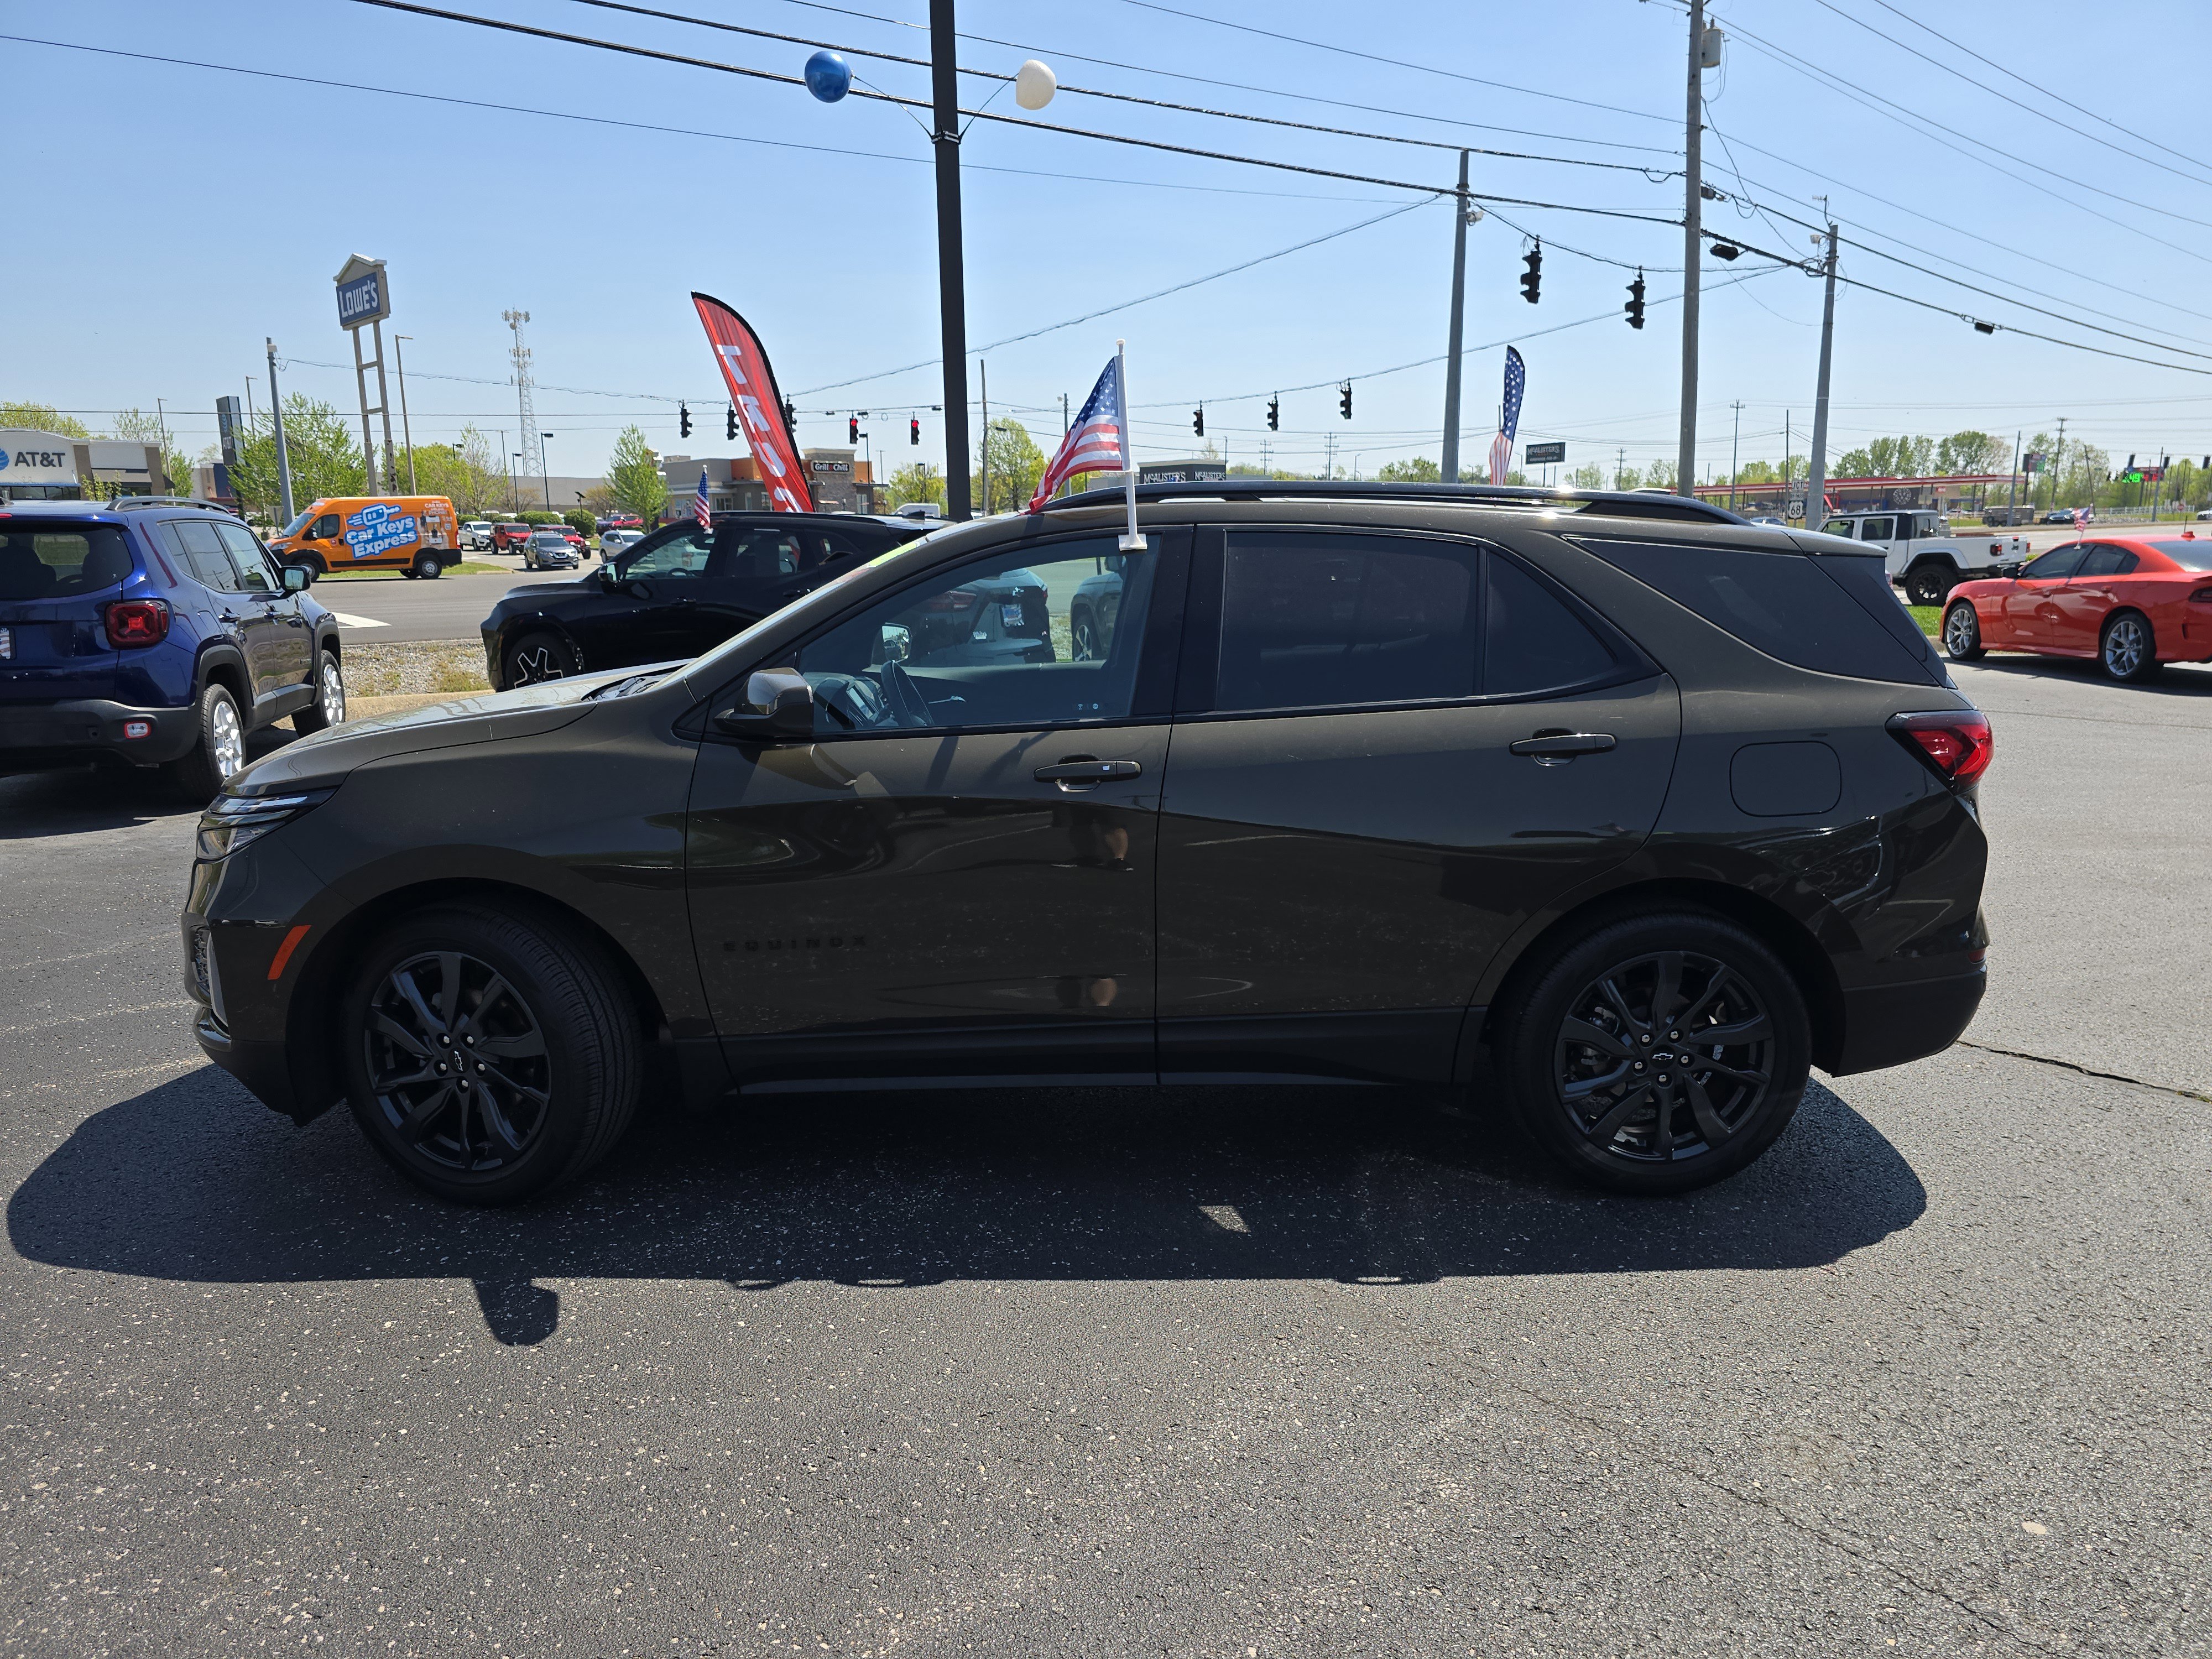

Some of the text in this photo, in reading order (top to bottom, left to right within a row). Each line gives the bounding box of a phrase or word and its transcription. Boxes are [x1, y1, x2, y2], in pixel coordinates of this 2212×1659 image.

[339, 280, 378, 318] LOWE'S
[14, 451, 66, 467] AT&T
[1791, 505, 1801, 515] 68
[346, 517, 414, 544] Car Keys
[354, 530, 416, 557] Express
[723, 935, 866, 952] EQUINOX
